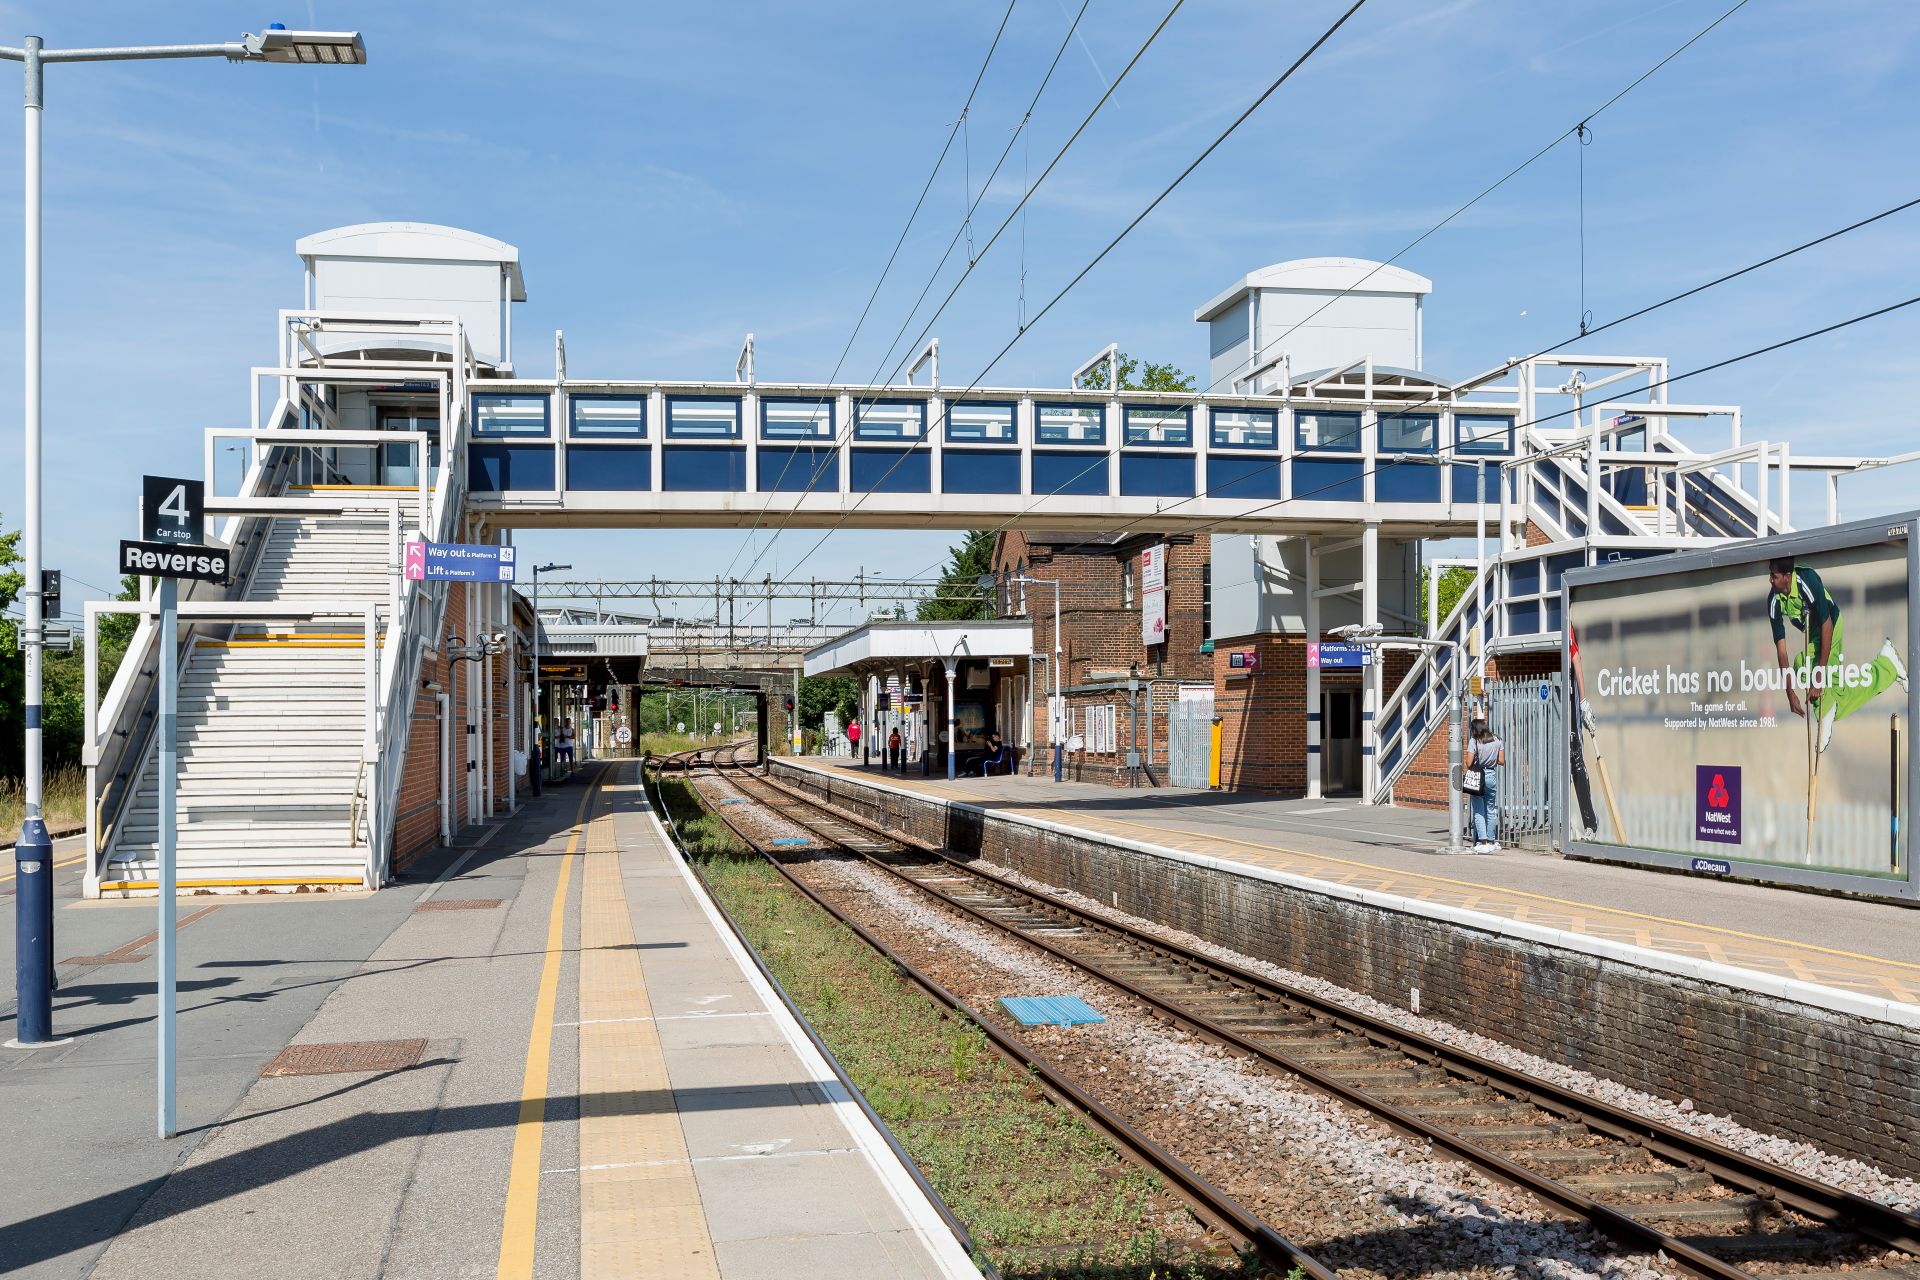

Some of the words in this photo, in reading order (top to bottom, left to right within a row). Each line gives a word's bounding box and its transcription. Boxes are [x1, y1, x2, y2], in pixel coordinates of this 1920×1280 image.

[158, 484, 190, 526] 4
[156, 528, 171, 537] Car
[173, 530, 191, 540] stop
[428, 547, 448, 558] Way
[450, 548, 466, 558] out
[126, 547, 225, 575] Reverse
[427, 566, 444, 575] Lift
[1598, 667, 1660, 696] Cricket
[1666, 664, 1700, 694] has
[1707, 670, 1732, 692] no
[1740, 654, 1873, 692] boundaries
[1690, 702, 1703, 712] The
[1704, 703, 1723, 714] game
[1724, 701, 1735, 711] for
[1737, 700, 1747, 711] all.
[1664, 717, 1696, 730] Supported
[1698, 718, 1707, 730] by
[1708, 718, 1737, 728] NatWest
[1739, 717, 1757, 728] since
[1759, 717, 1778, 728] 1981.
[1706, 812, 1731, 823] NatWest
[1695, 860, 1726, 873] JCDecaux
